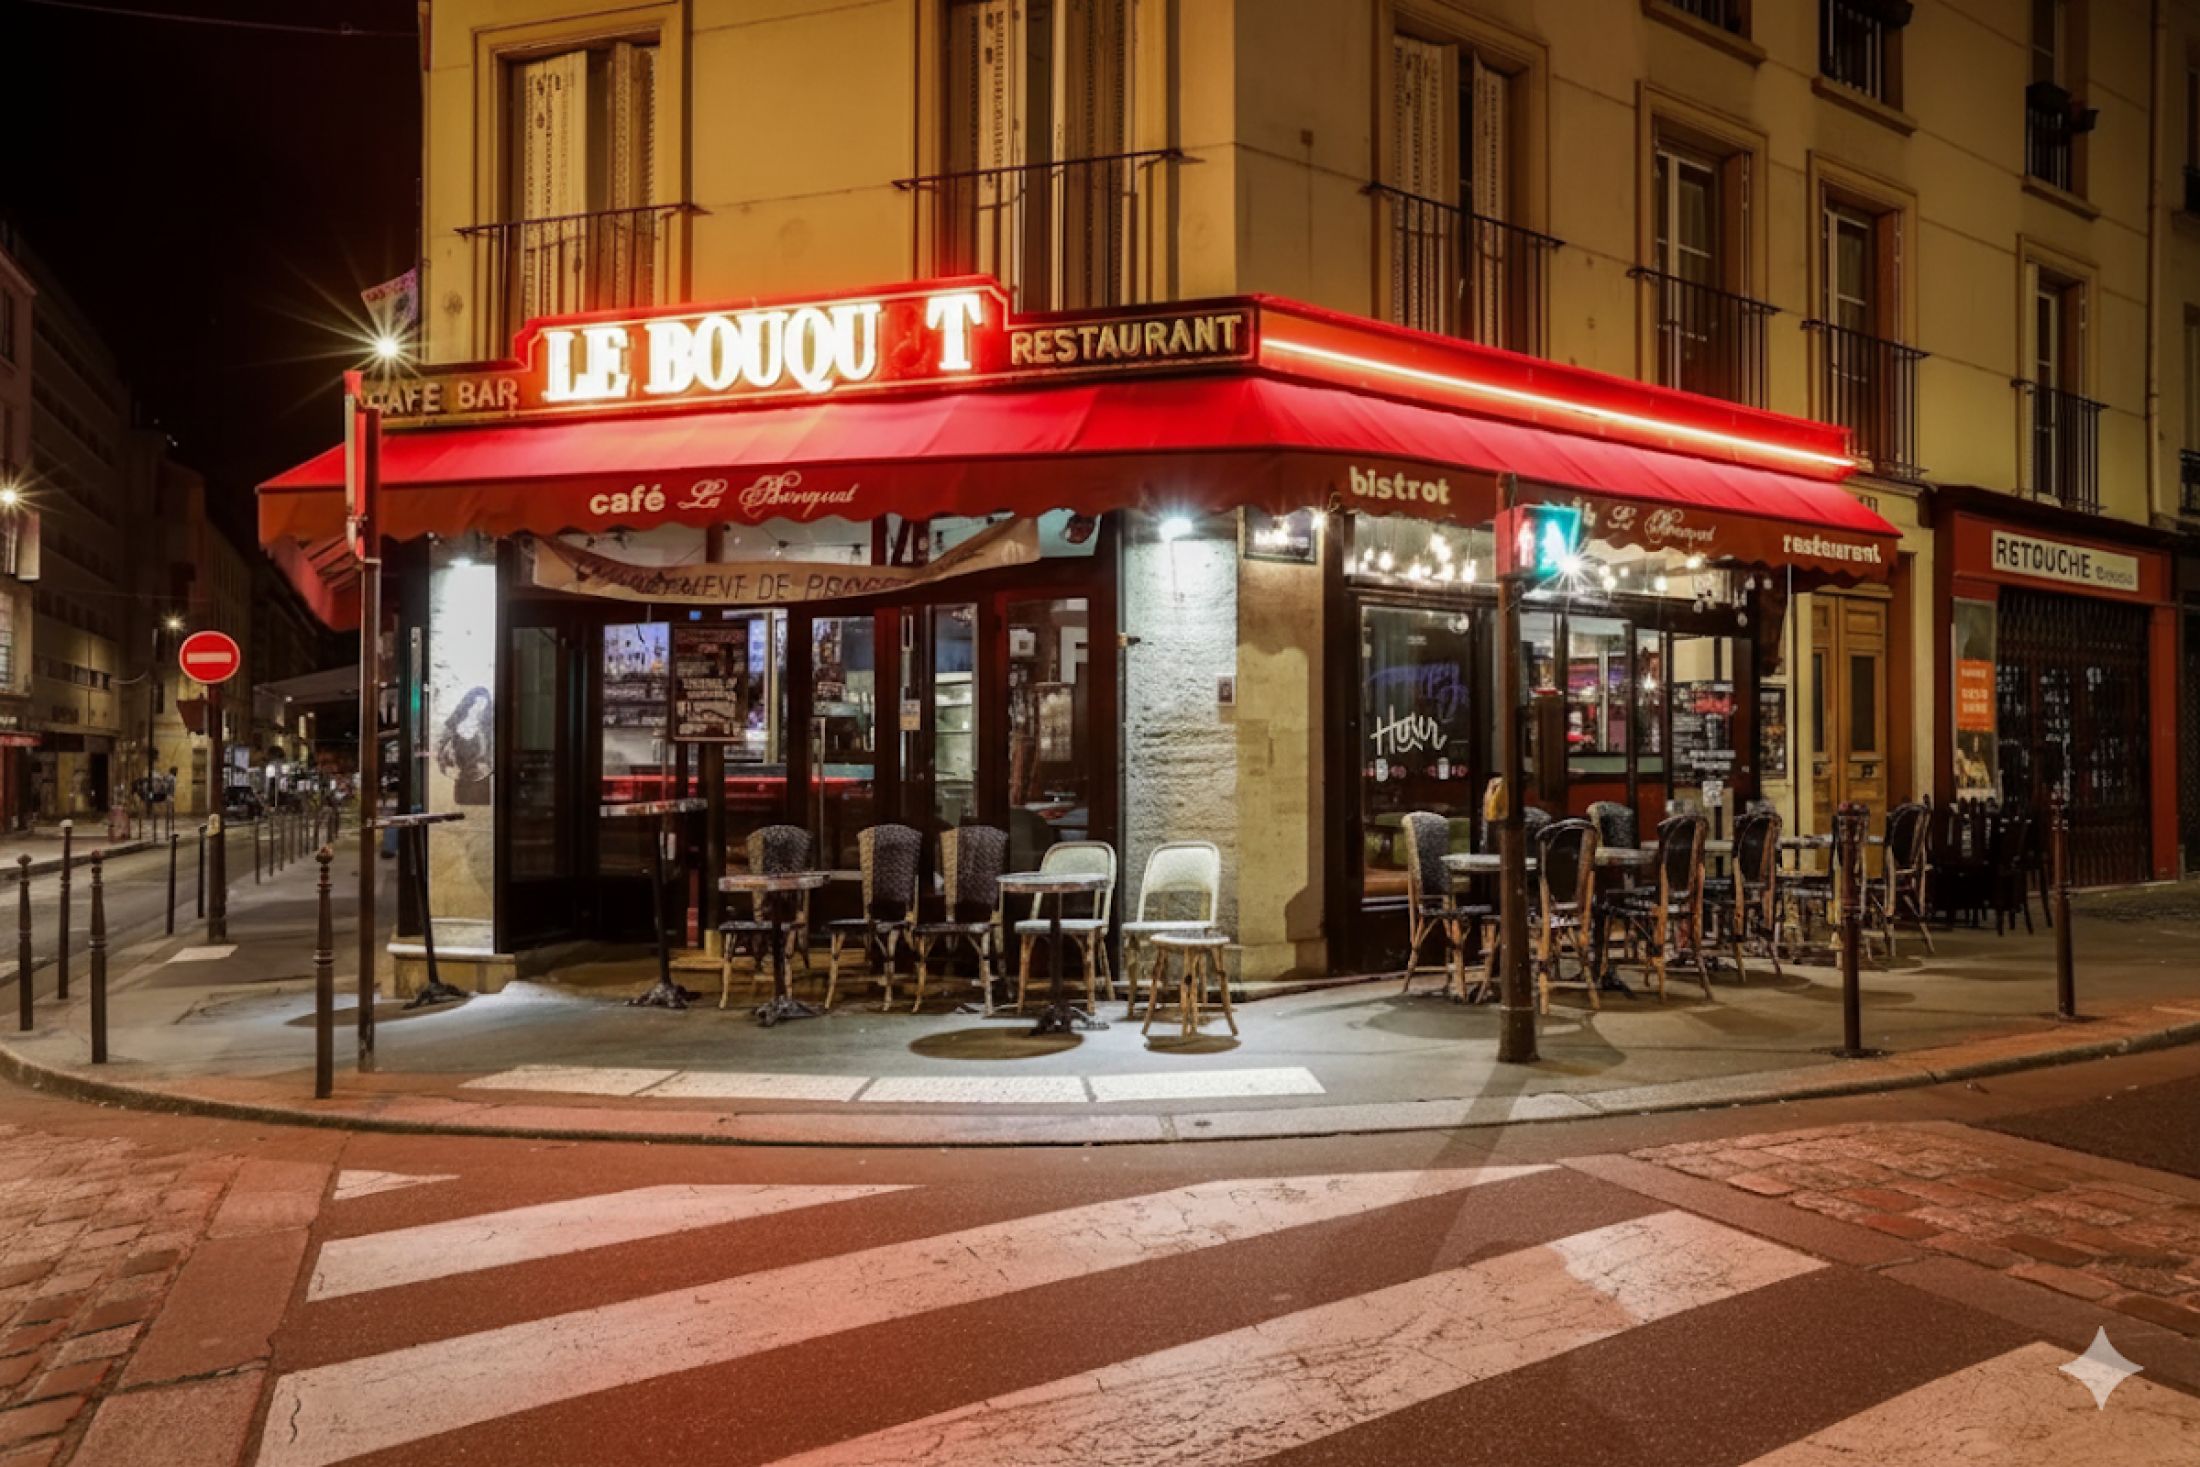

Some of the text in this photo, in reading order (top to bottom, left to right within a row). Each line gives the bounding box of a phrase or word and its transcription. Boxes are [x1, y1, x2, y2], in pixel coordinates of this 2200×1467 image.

[1011, 315, 1242, 365] RESTAURANT
[543, 328, 629, 402] LE
[457, 378, 518, 410] BAR
[589, 484, 666, 515] café
[1349, 466, 1450, 504] bistrot
[1995, 538, 2091, 578] RETOUCHE
